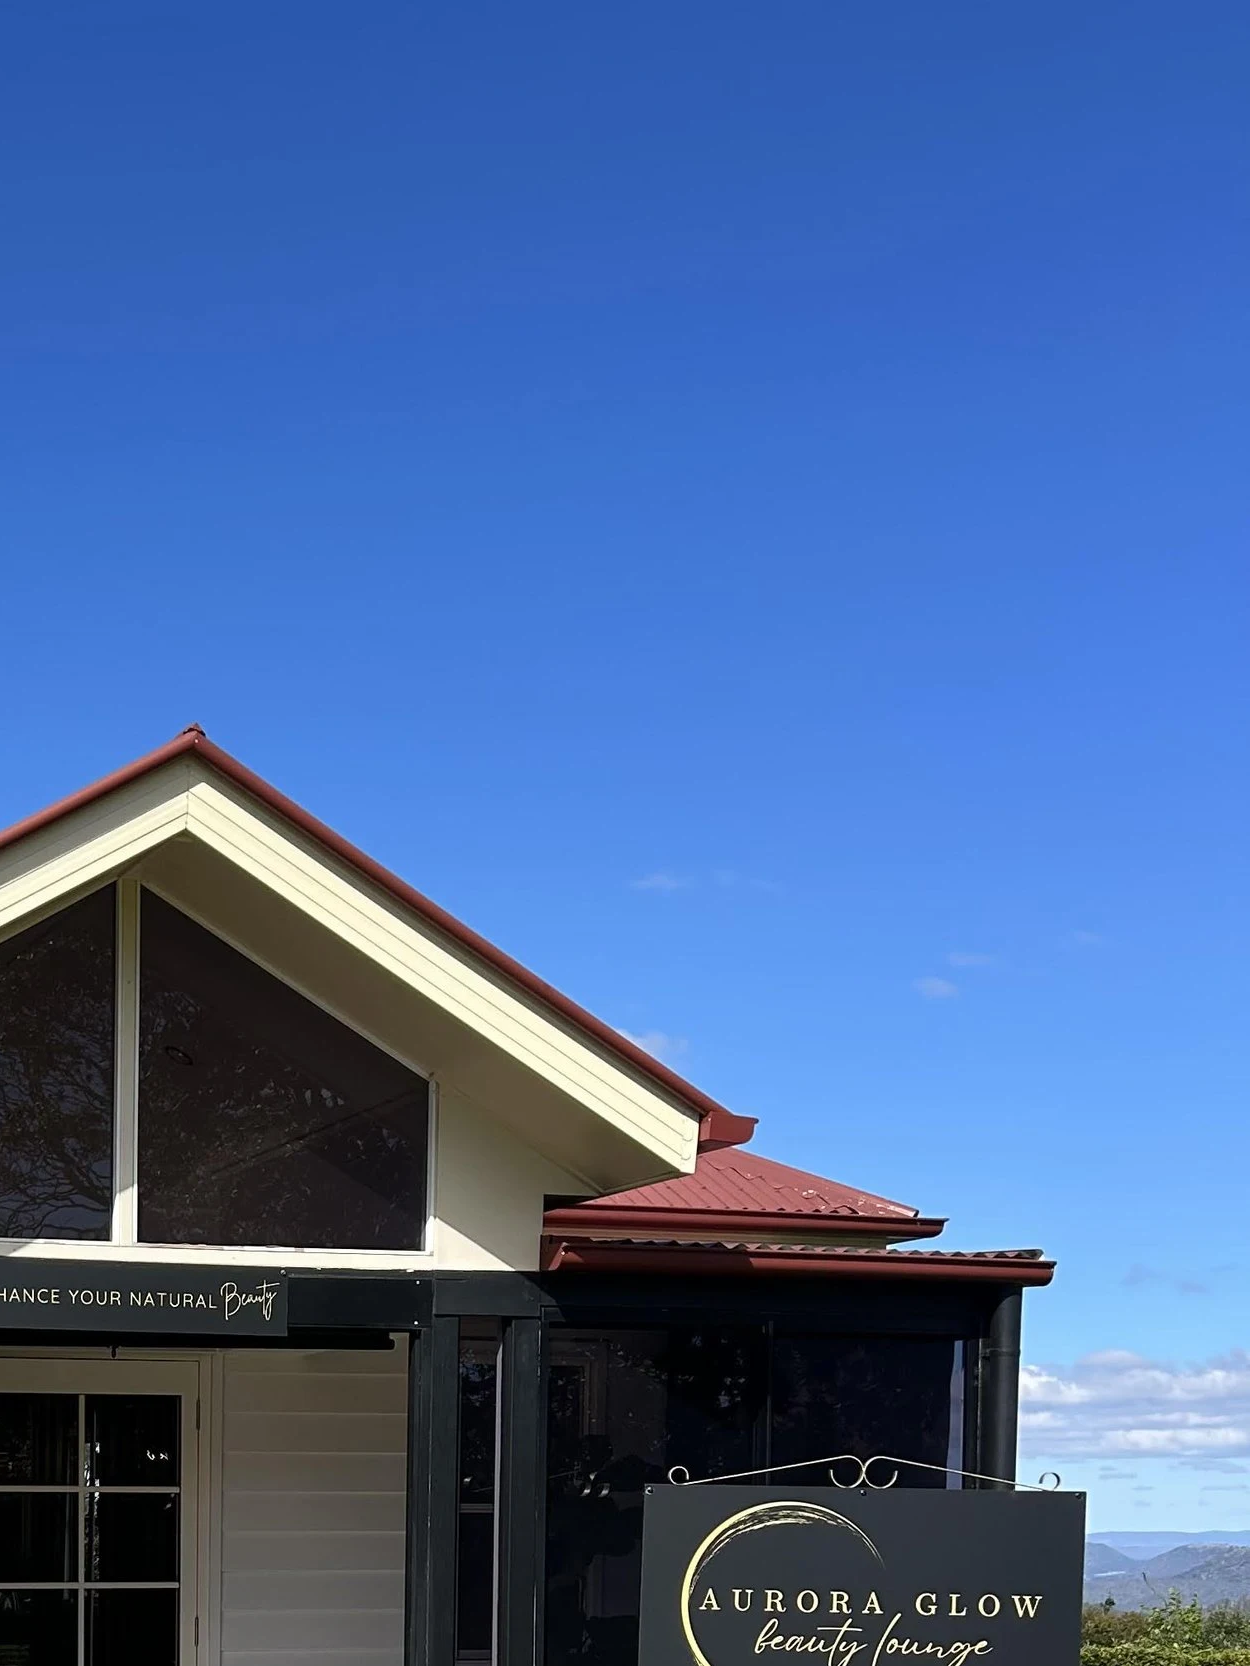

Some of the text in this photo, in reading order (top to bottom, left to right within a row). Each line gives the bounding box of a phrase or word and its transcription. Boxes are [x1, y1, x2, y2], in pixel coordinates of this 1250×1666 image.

[68, 1289, 121, 1306] YOUR
[129, 1291, 217, 1309] NATURAL
[220, 1279, 281, 1321] Beauty
[699, 1588, 1043, 1618] AURORA GLOW
